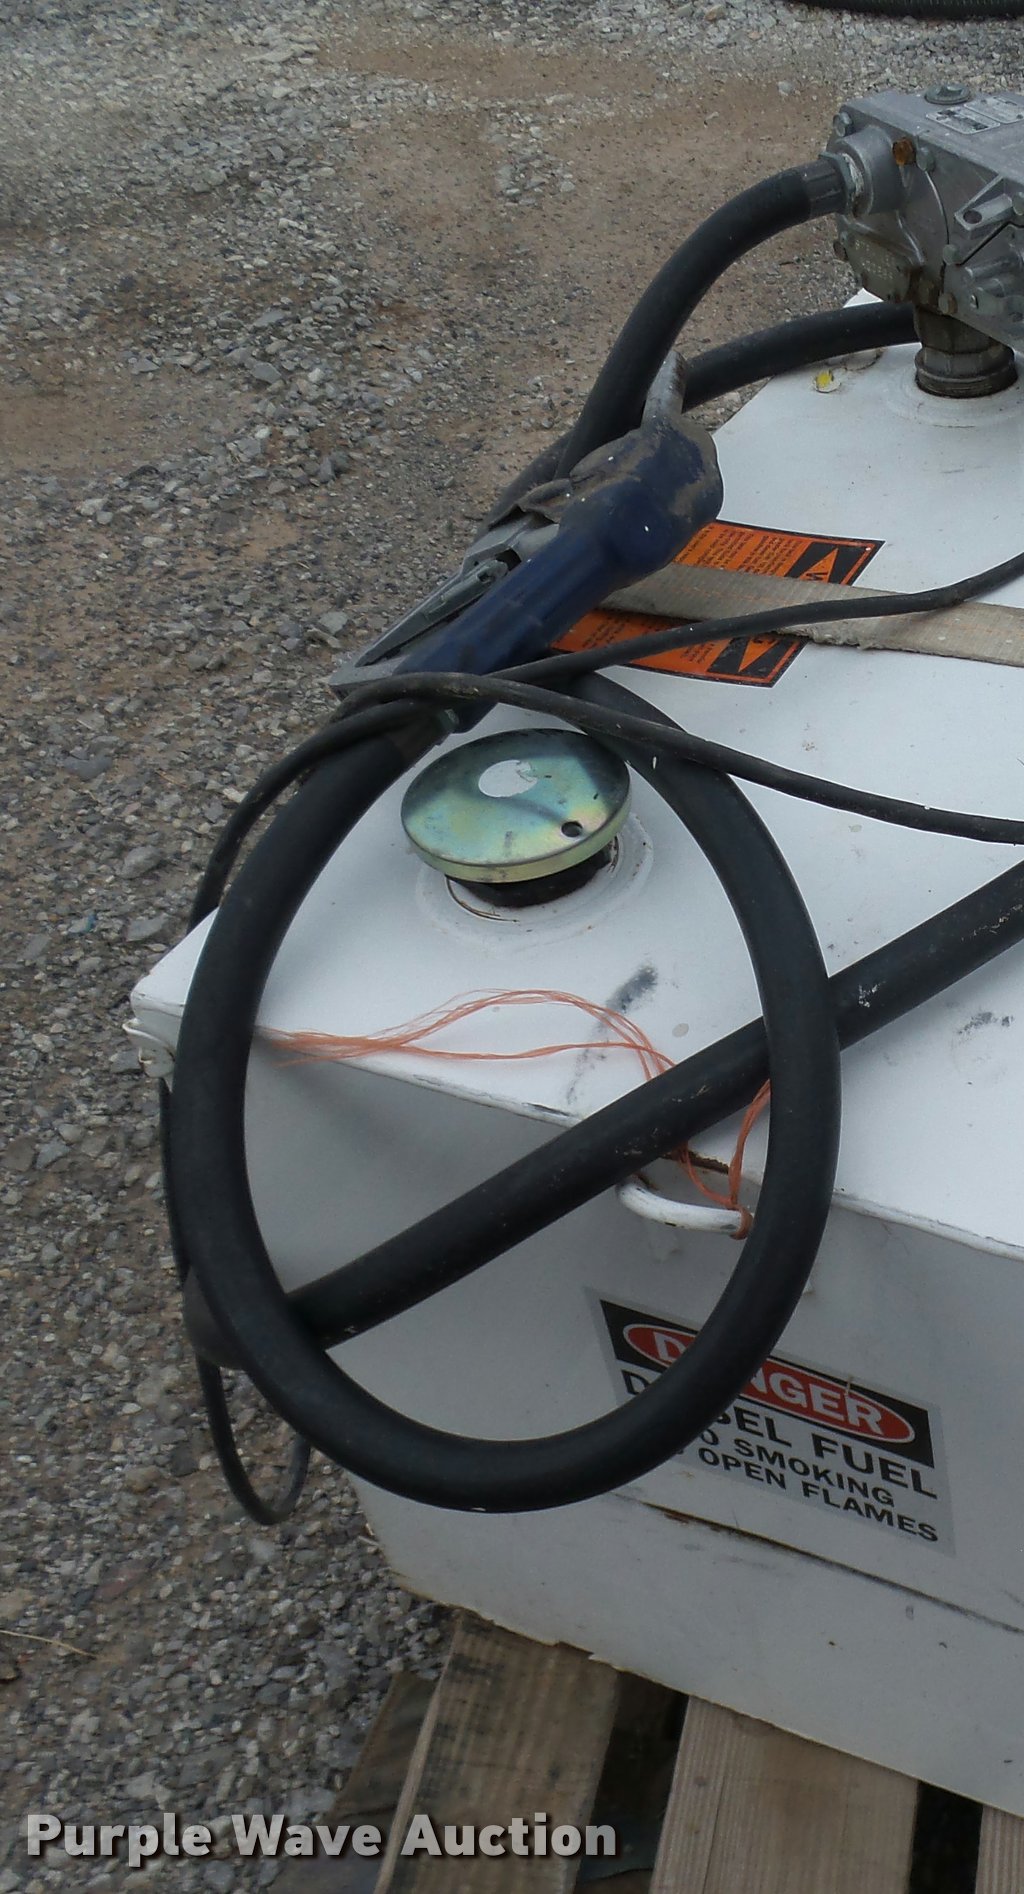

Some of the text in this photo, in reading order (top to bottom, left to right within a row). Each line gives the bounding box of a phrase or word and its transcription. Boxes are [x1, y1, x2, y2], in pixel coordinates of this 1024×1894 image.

[697, 1447, 939, 1542] OPEN FLAMES
[733, 1438, 895, 1507] SMOKING
[811, 1432, 938, 1500] FUEL
